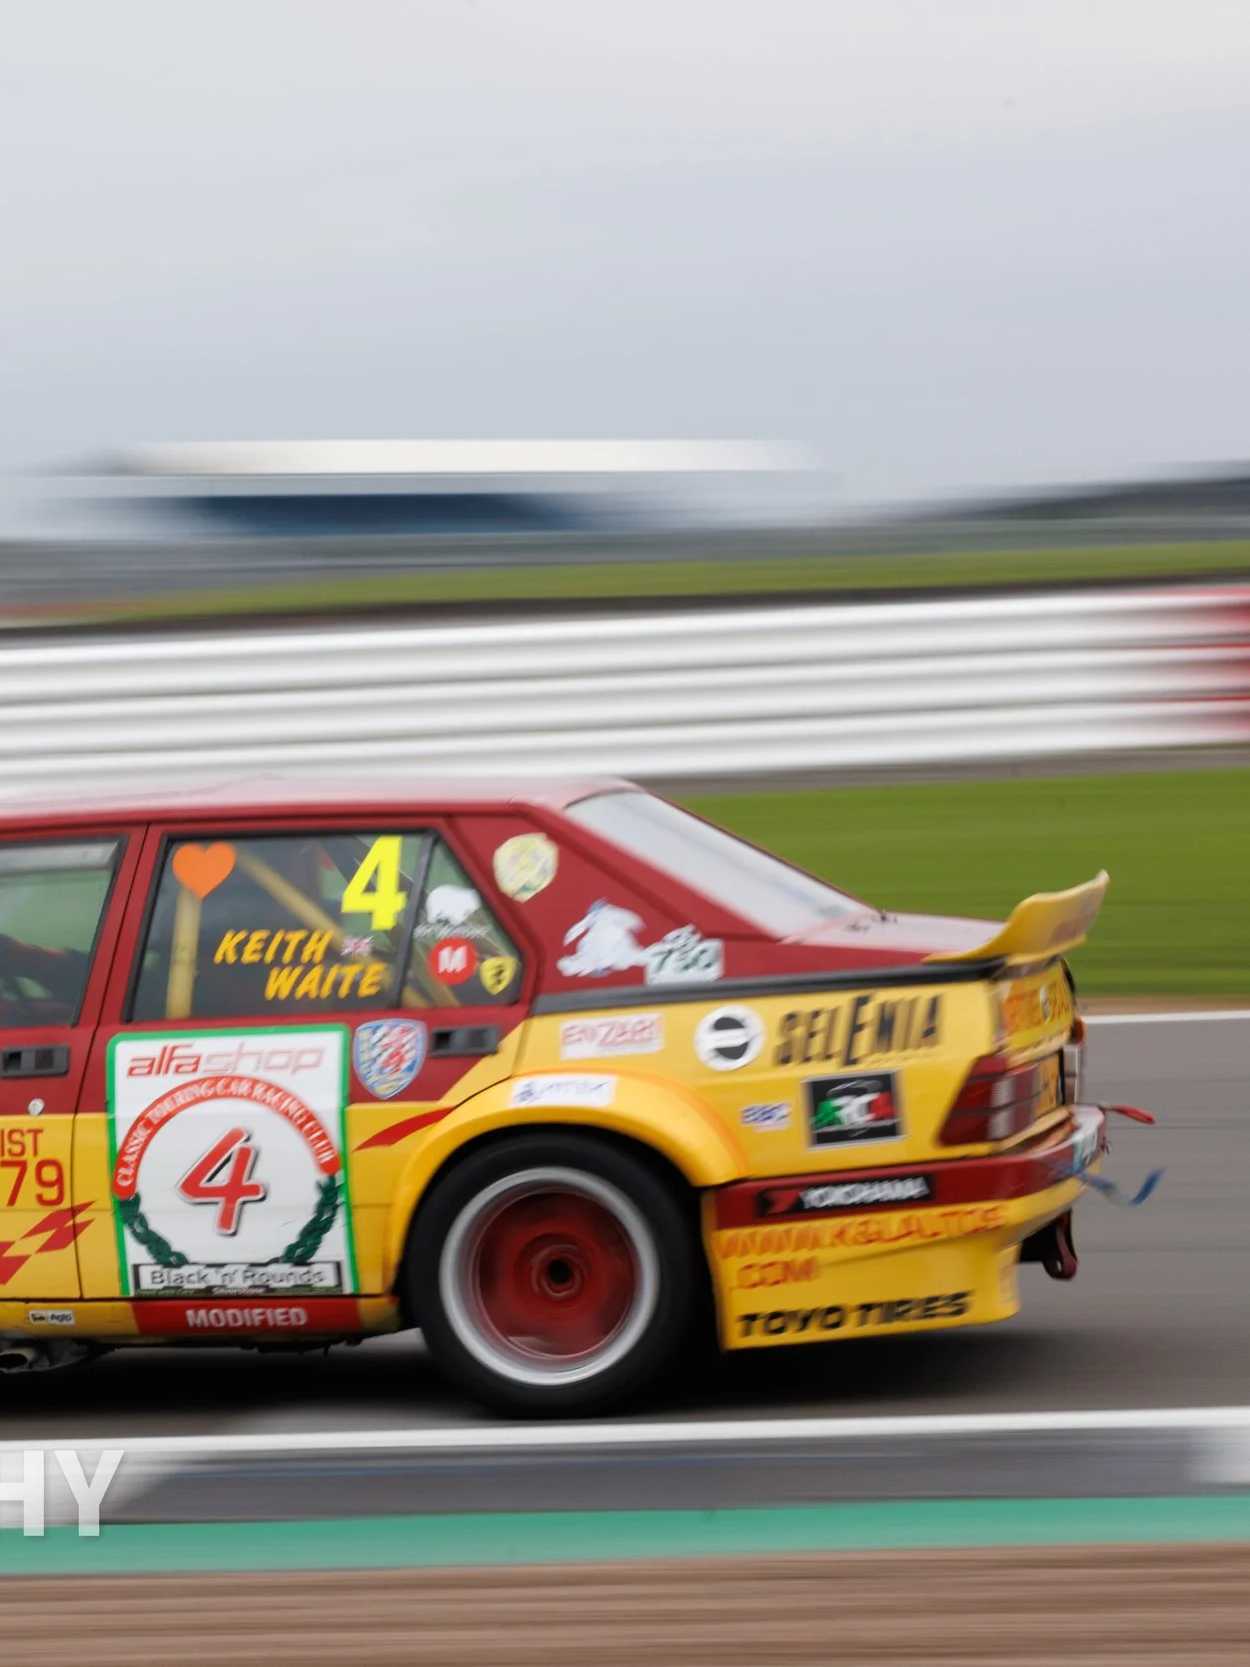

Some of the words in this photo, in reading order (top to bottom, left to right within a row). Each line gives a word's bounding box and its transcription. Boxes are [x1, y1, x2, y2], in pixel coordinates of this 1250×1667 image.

[341, 835, 408, 931] 4
[213, 928, 335, 965] KEITH
[264, 962, 388, 1000] WAITE
[775, 993, 944, 1067] SELENIA
[126, 1040, 327, 1078] alfashop
[116, 1120, 149, 1187] CLASSIC
[148, 1080, 216, 1124] TOURING
[215, 1077, 252, 1098] CAR
[250, 1080, 308, 1125] RACING
[303, 1116, 337, 1164] CLUB
[176, 1125, 268, 1237] 4
[800, 1176, 931, 1210] YOKOHAMA
[150, 1268, 209, 1286] Black
[243, 1266, 327, 1285] Rounds
[185, 1306, 309, 1328] MODIFIED
[738, 1305, 847, 1338] TOYO
[856, 1290, 972, 1328] TIRES
